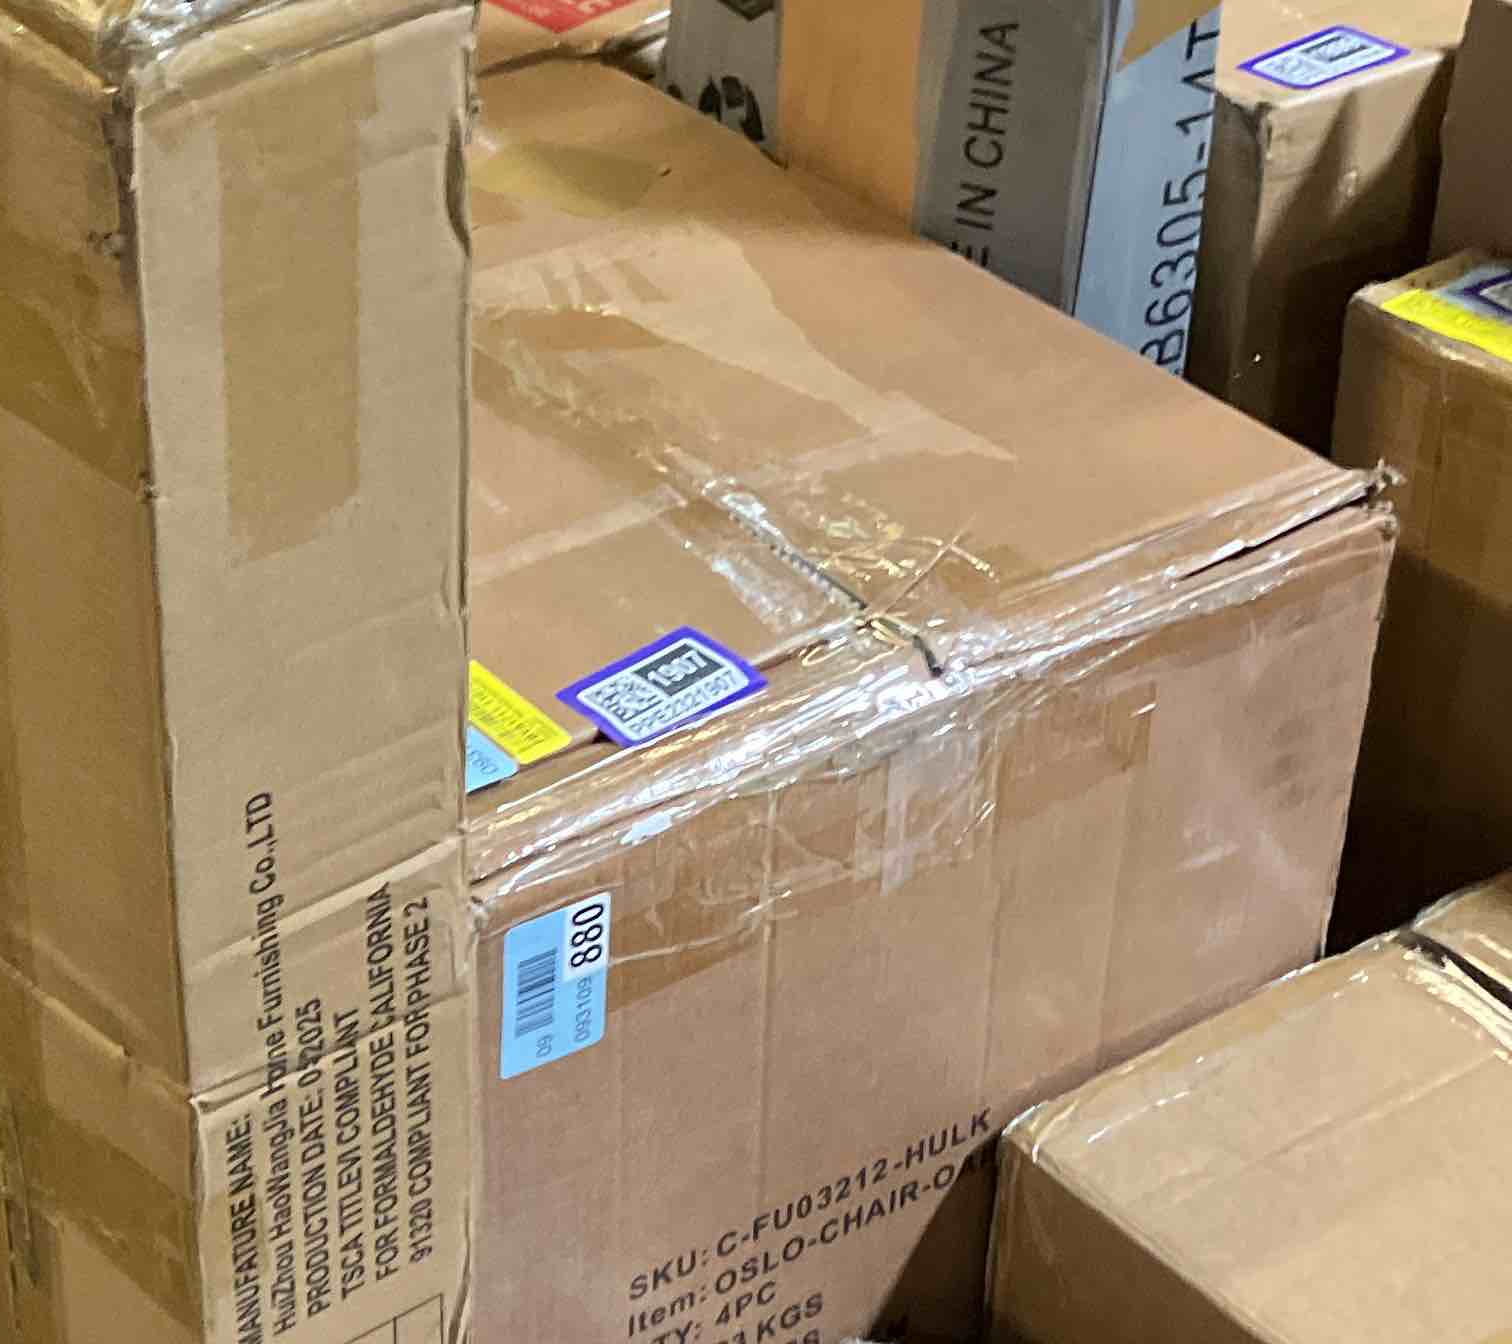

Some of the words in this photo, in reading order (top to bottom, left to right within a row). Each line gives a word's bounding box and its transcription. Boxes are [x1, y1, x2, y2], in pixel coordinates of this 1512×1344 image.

[964, 22, 1020, 170] CHINA
[1139, 19, 1220, 375] B6305-1AT
[647, 650, 707, 687] 1907
[404, 896, 429, 917] 2
[570, 904, 605, 968] 880
[251, 893, 285, 1031] Furnishing
[366, 881, 395, 1033] CALIFORNIA
[404, 916, 432, 1004] PHASE
[333, 1008, 361, 1147] COMPLIANT
[226, 1113, 255, 1197] NAME:
[298, 1088, 326, 1173] DATE:
[369, 1031, 398, 1231] FORMALDEHYDE
[406, 1061, 432, 1197] COMPLIANT
[301, 1163, 331, 1318] PRODUCTION
[340, 1232, 365, 1300] TSCA
[375, 1227, 399, 1283] FOR
[271, 1239, 297, 1337] HuiZhou
[715, 1280, 778, 1329] 4PC
[757, 1292, 825, 1344] KGS
